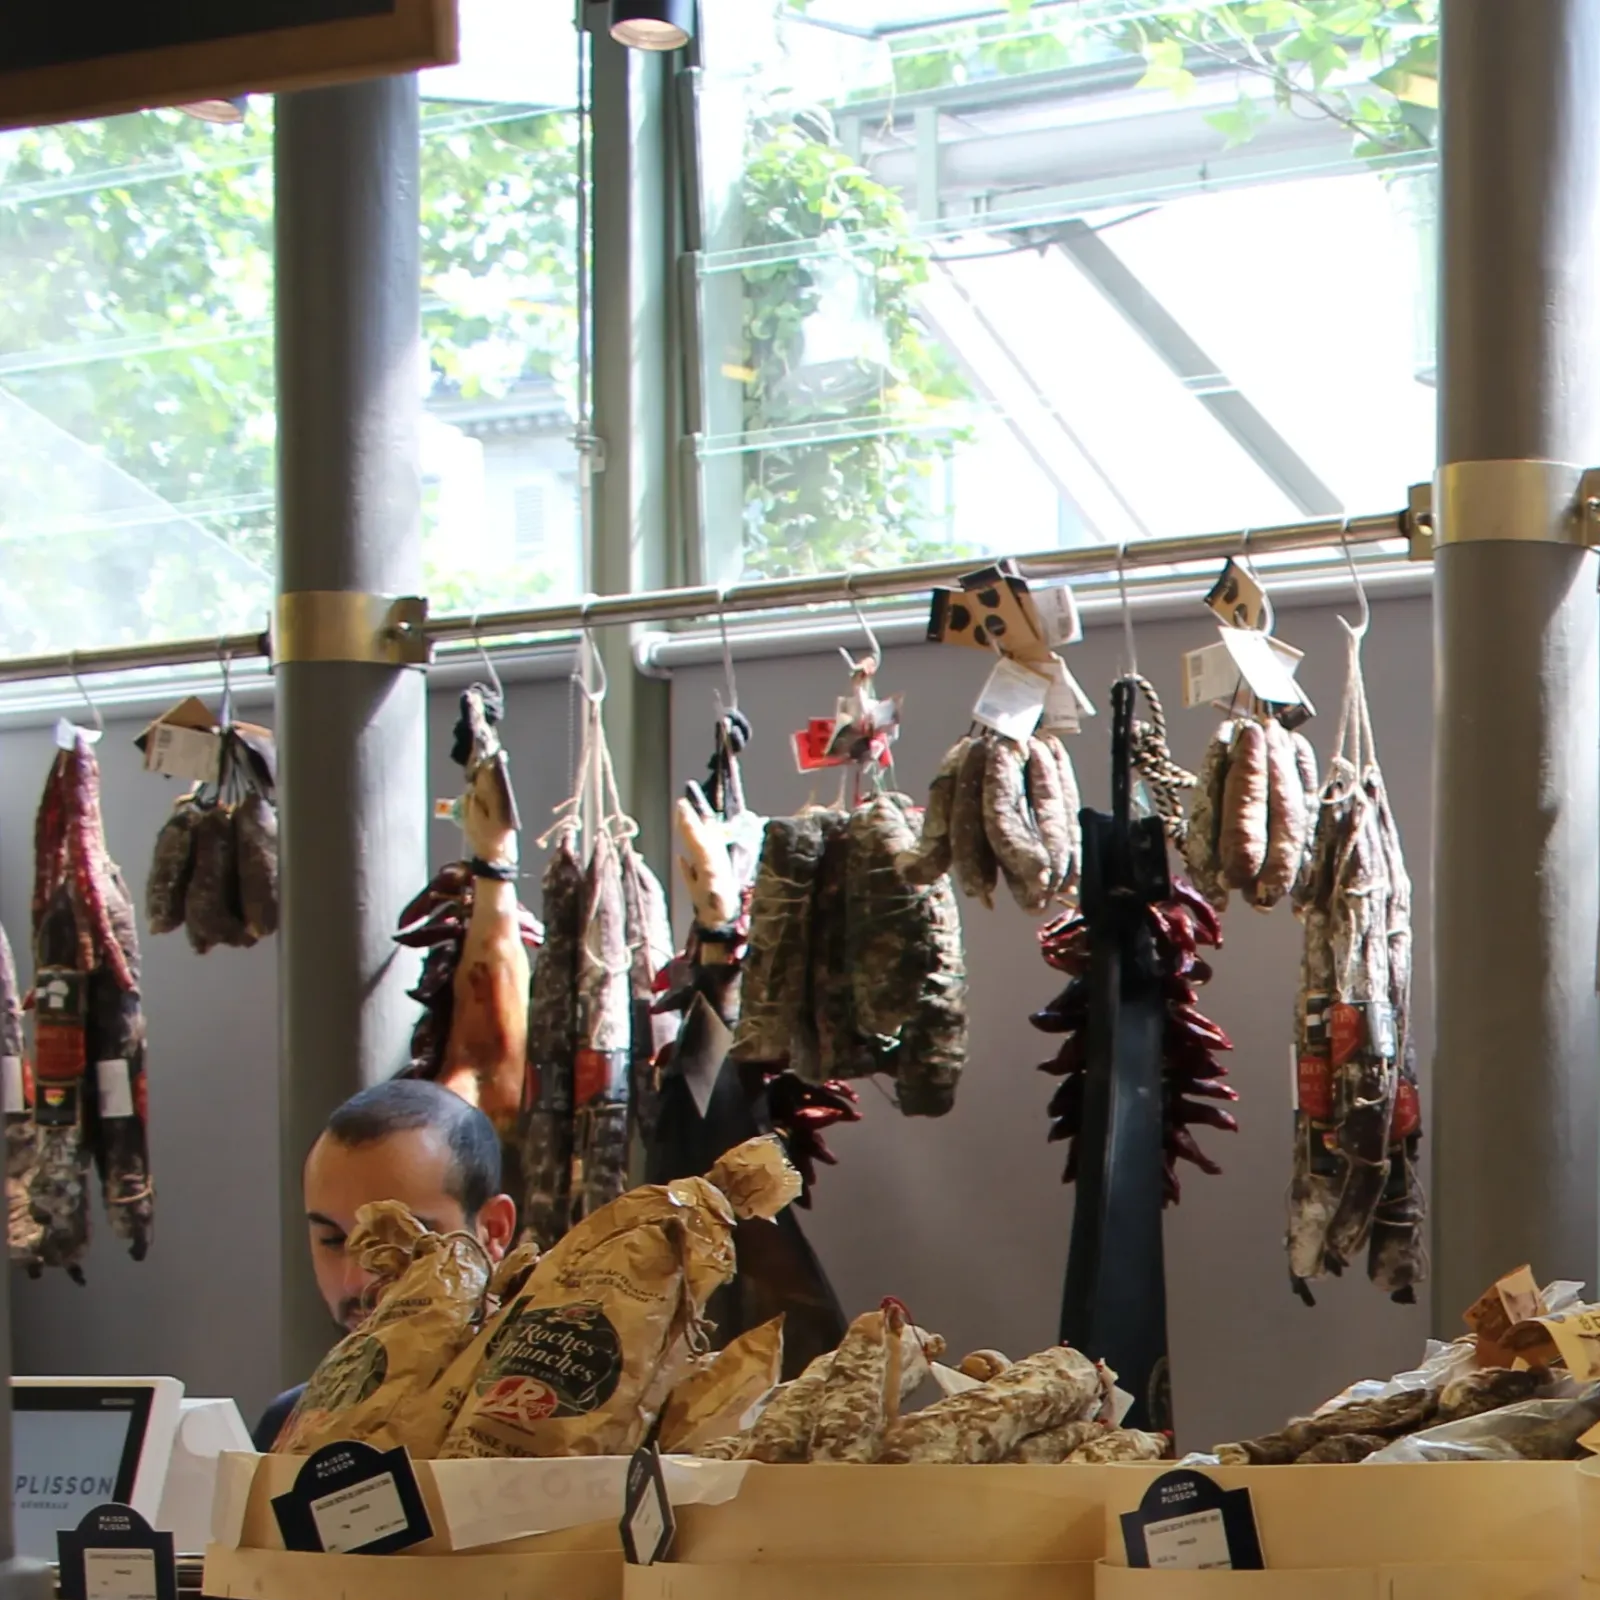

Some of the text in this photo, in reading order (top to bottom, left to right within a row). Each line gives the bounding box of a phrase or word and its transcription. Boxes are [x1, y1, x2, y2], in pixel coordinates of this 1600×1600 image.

[518, 1323, 597, 1357] Roches
[500, 1340, 597, 1382] Blanches
[14, 1475, 115, 1496] PLISSON
